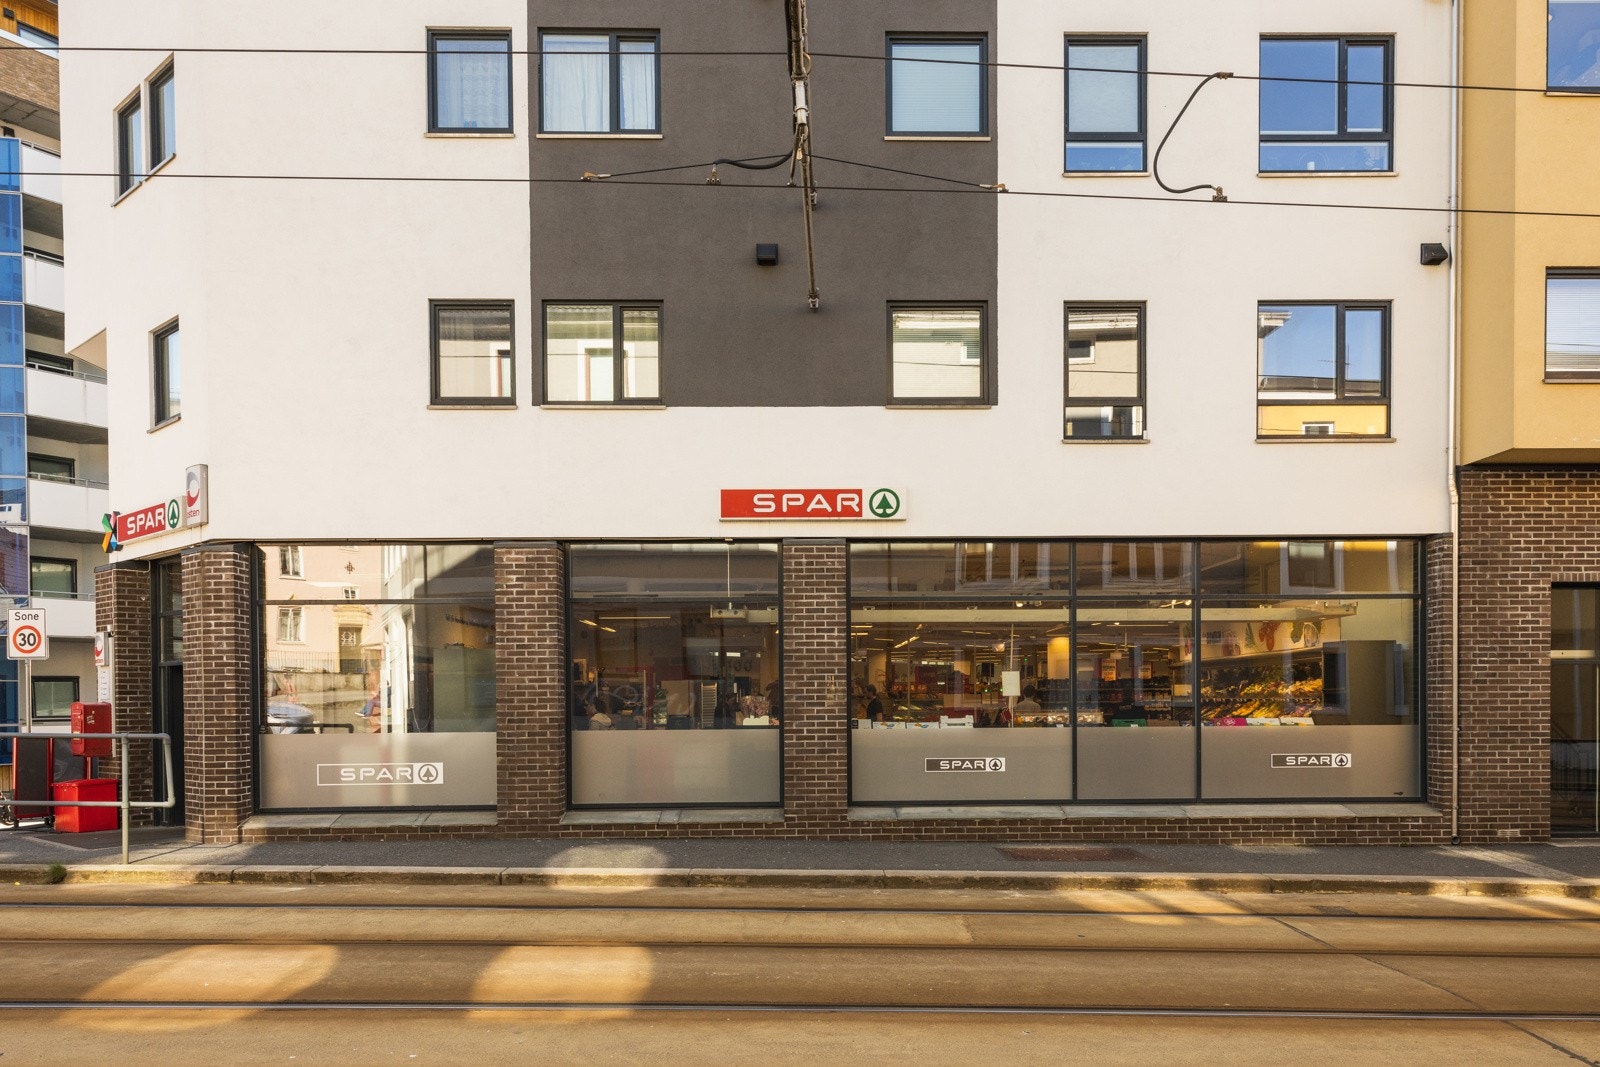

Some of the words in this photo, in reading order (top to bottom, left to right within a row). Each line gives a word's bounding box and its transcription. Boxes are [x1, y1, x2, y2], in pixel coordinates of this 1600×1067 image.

[753, 493, 860, 513] SPAR
[187, 509, 200, 519] sten
[126, 507, 165, 536] SPAR
[14, 611, 39, 621] Sone
[18, 632, 37, 647] 30
[940, 760, 985, 770] SPAR
[1285, 756, 1331, 765] SPAR
[340, 767, 413, 781] SPAR
